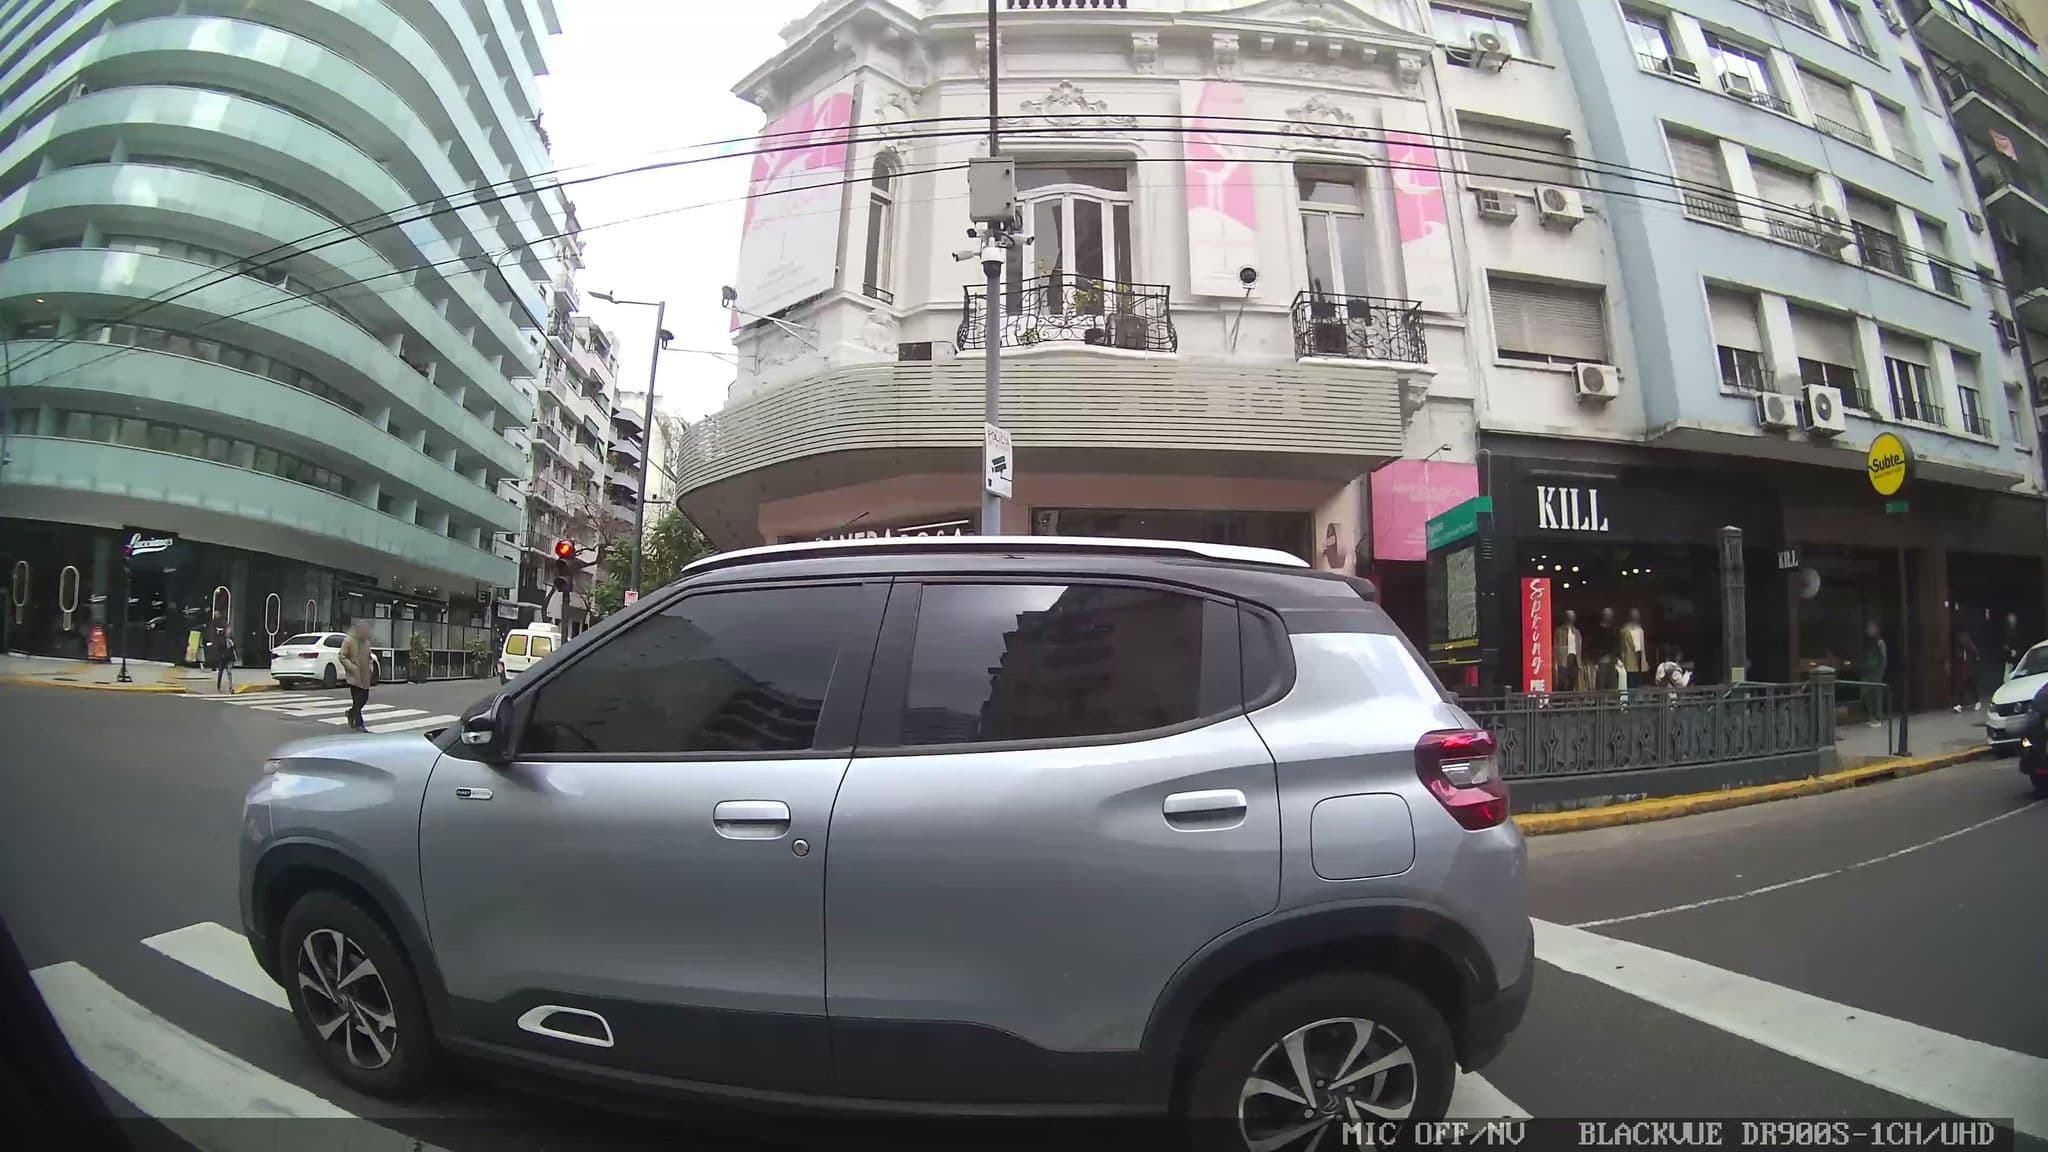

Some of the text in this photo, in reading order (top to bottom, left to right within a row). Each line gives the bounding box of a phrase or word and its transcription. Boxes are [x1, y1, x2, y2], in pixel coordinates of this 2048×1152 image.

[1871, 453, 1901, 472] Subte
[1537, 486, 1608, 531] KILL
[1779, 550, 1798, 569] KILL
